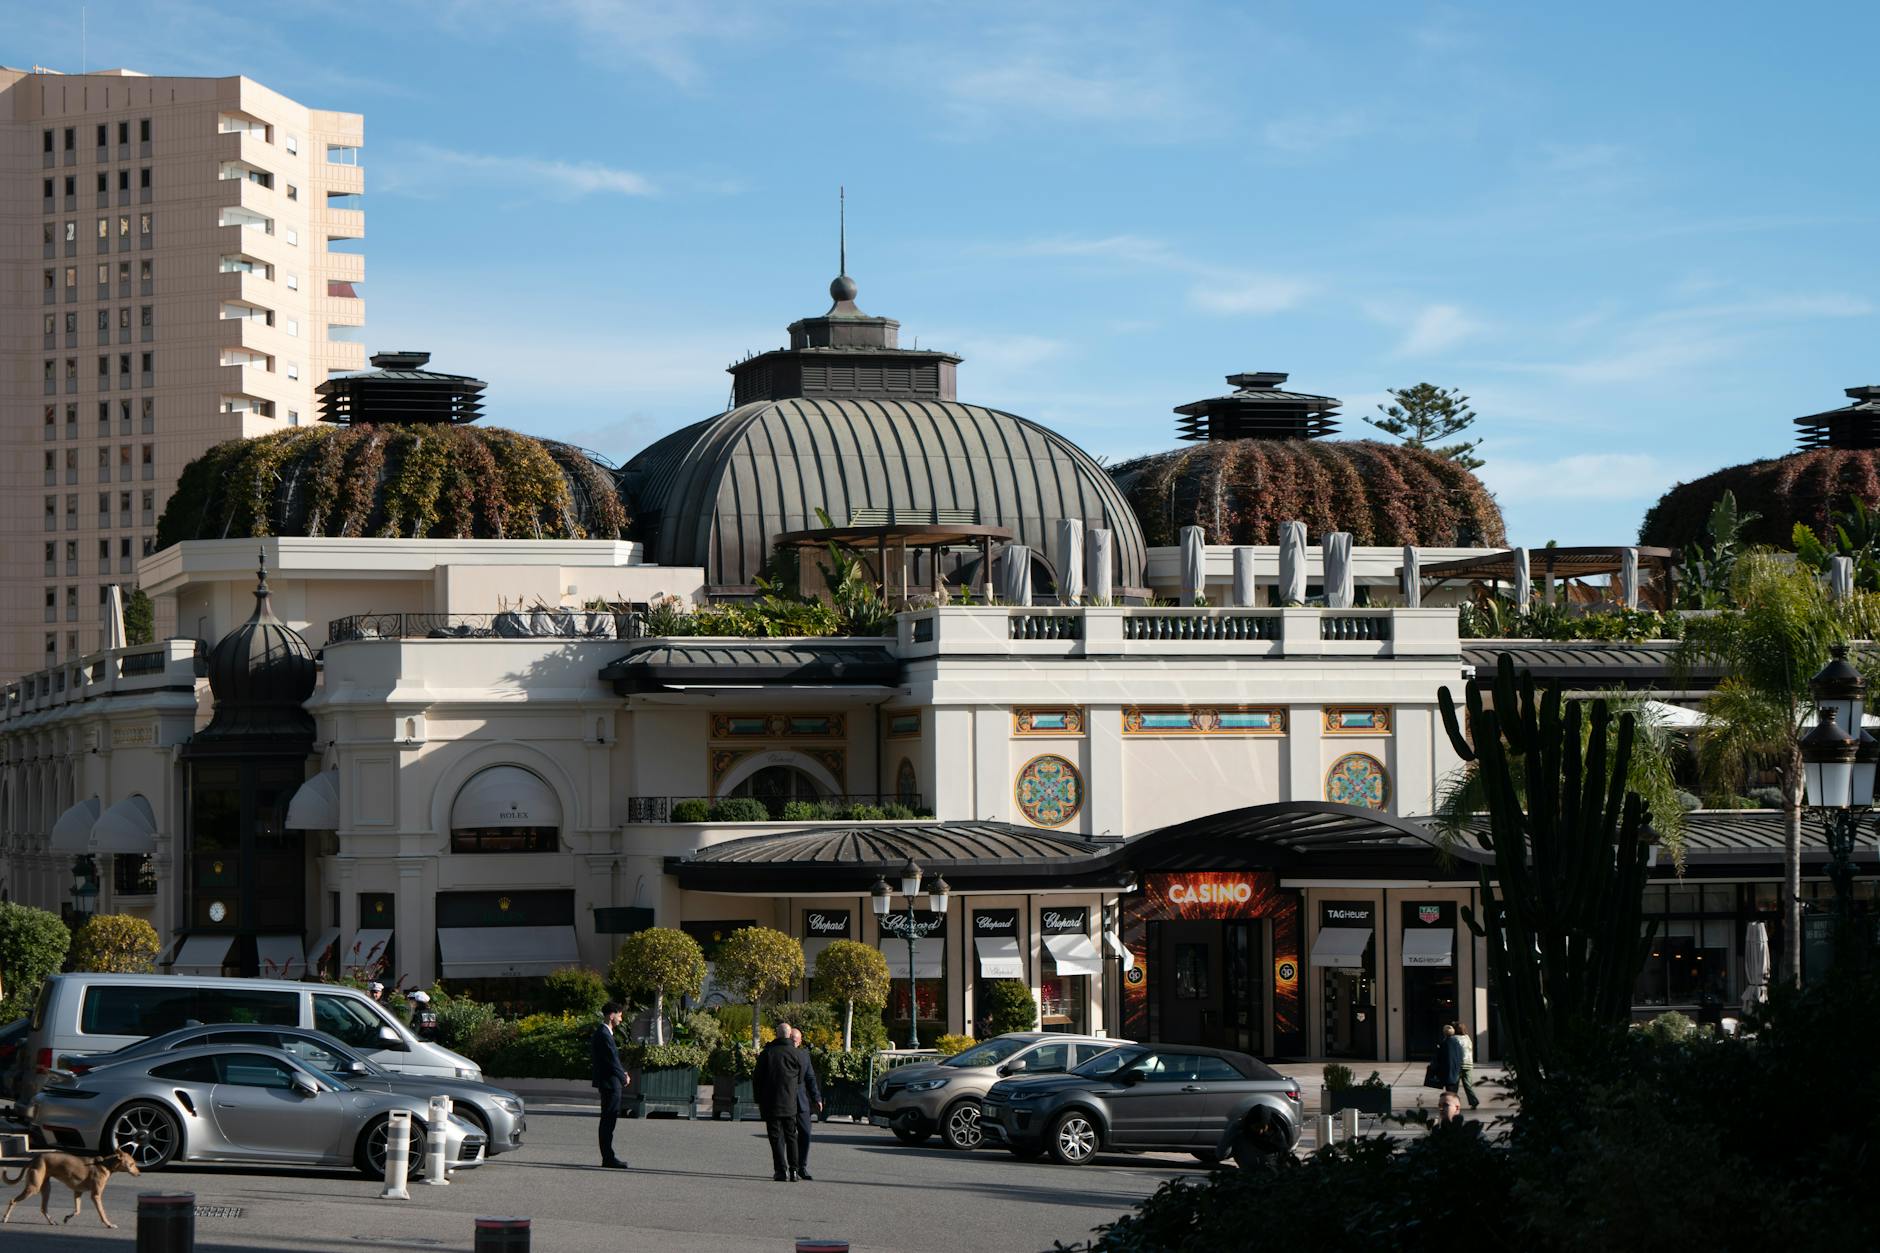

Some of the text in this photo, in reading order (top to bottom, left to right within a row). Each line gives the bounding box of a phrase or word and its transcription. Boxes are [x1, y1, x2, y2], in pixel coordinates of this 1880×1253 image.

[1168, 883, 1252, 904] CASINO
[809, 913, 847, 933] Chopard
[976, 916, 1014, 930] Chopard
[1043, 911, 1084, 931] Chopard
